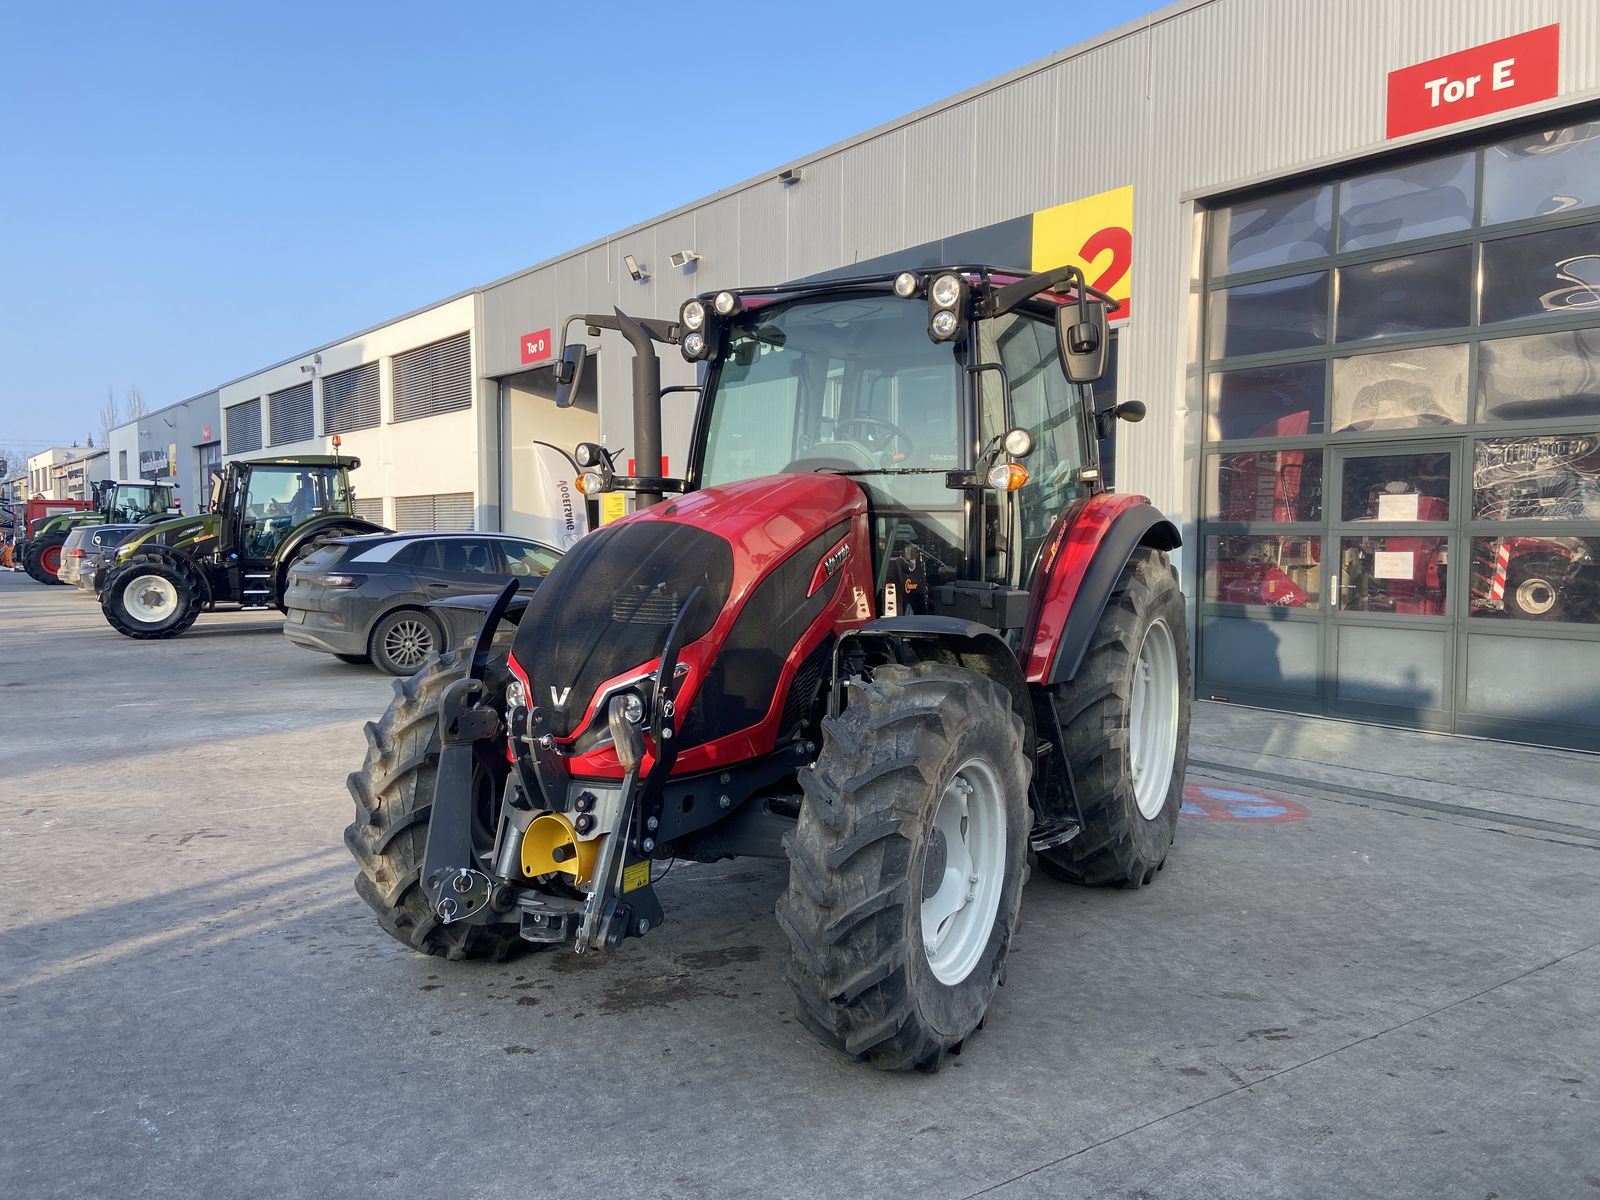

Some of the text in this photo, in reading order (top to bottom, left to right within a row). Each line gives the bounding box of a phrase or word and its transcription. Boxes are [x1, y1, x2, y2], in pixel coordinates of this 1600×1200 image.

[1424, 57, 1515, 108] Tor E
[1078, 226, 1132, 320] 2
[527, 339, 545, 355] Tor D
[550, 685, 571, 706] V
